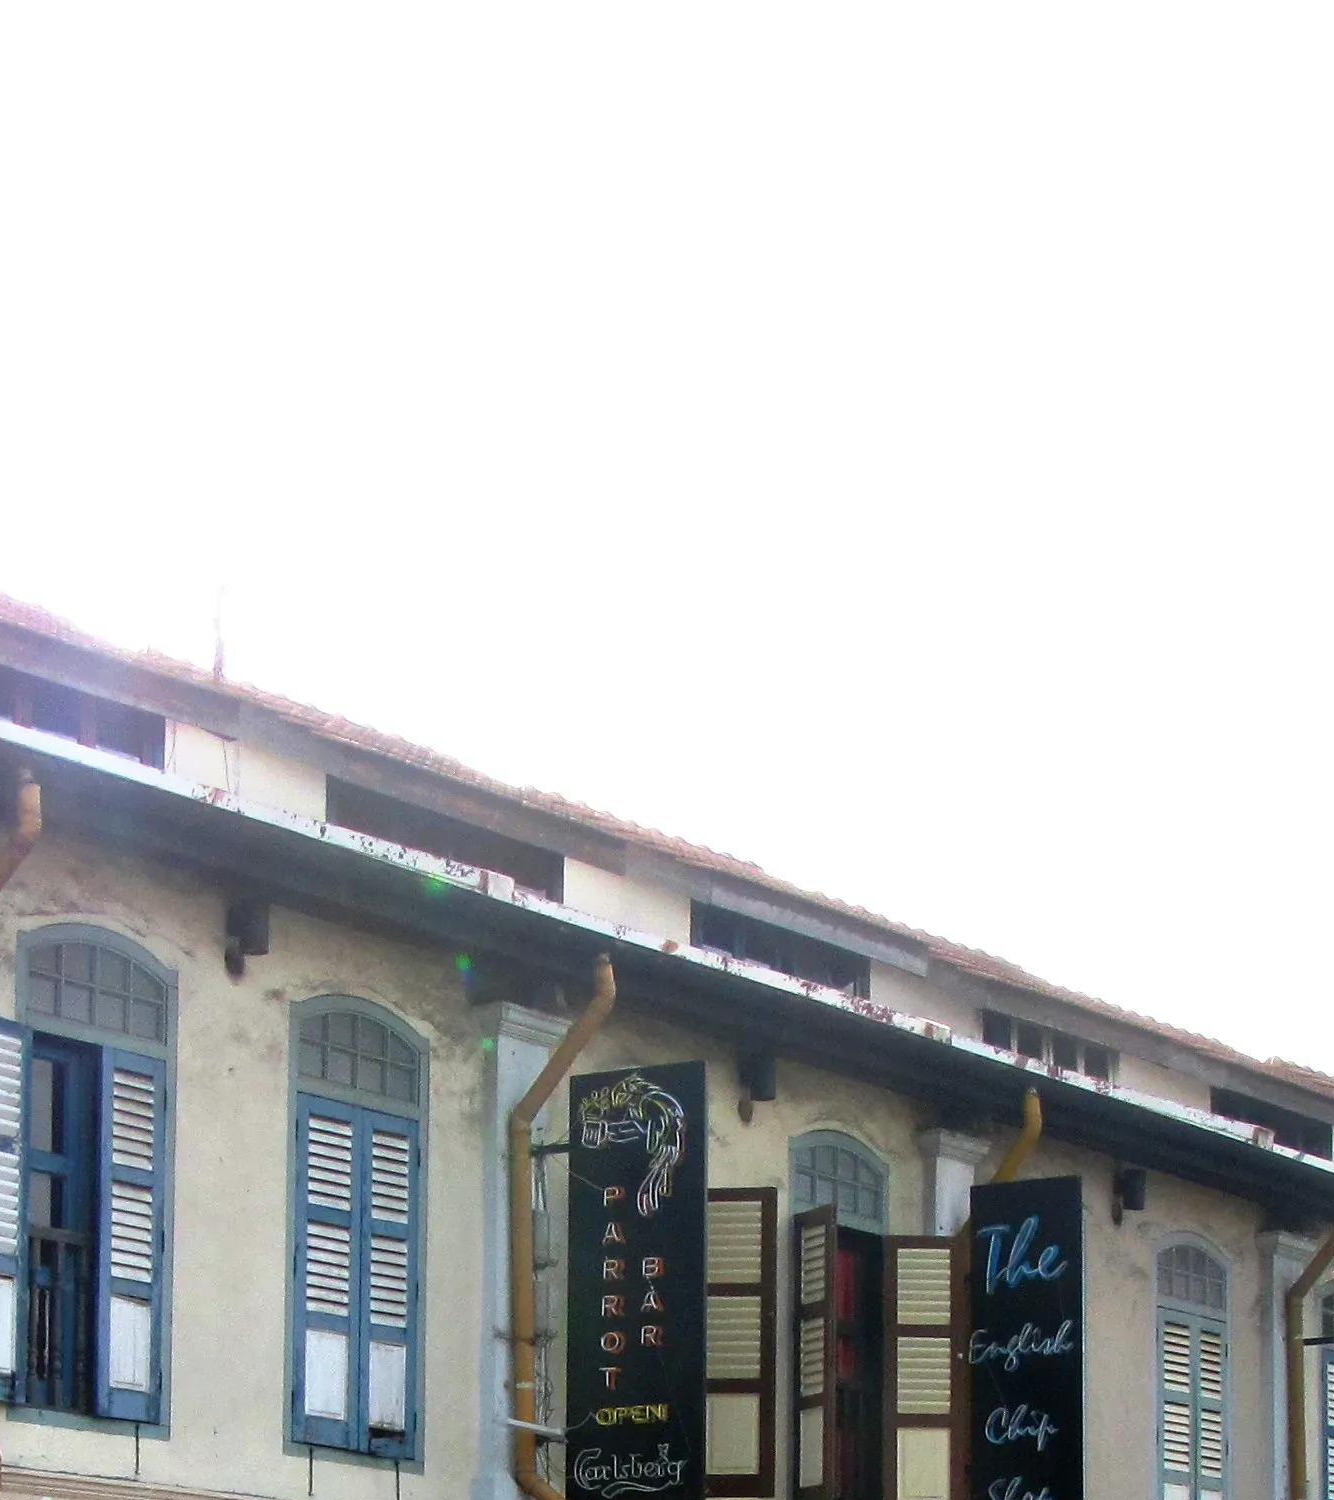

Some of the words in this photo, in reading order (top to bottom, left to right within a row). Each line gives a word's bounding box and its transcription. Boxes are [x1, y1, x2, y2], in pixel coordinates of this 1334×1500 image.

[977, 1212, 1069, 1296] The
[600, 1186, 626, 1390] PARROT
[640, 1256, 665, 1346] BAR
[968, 1318, 1073, 1371] English
[596, 1403, 666, 1427] OPEN
[983, 1402, 1059, 1452] Chip
[574, 1445, 687, 1496] Carlsberg
